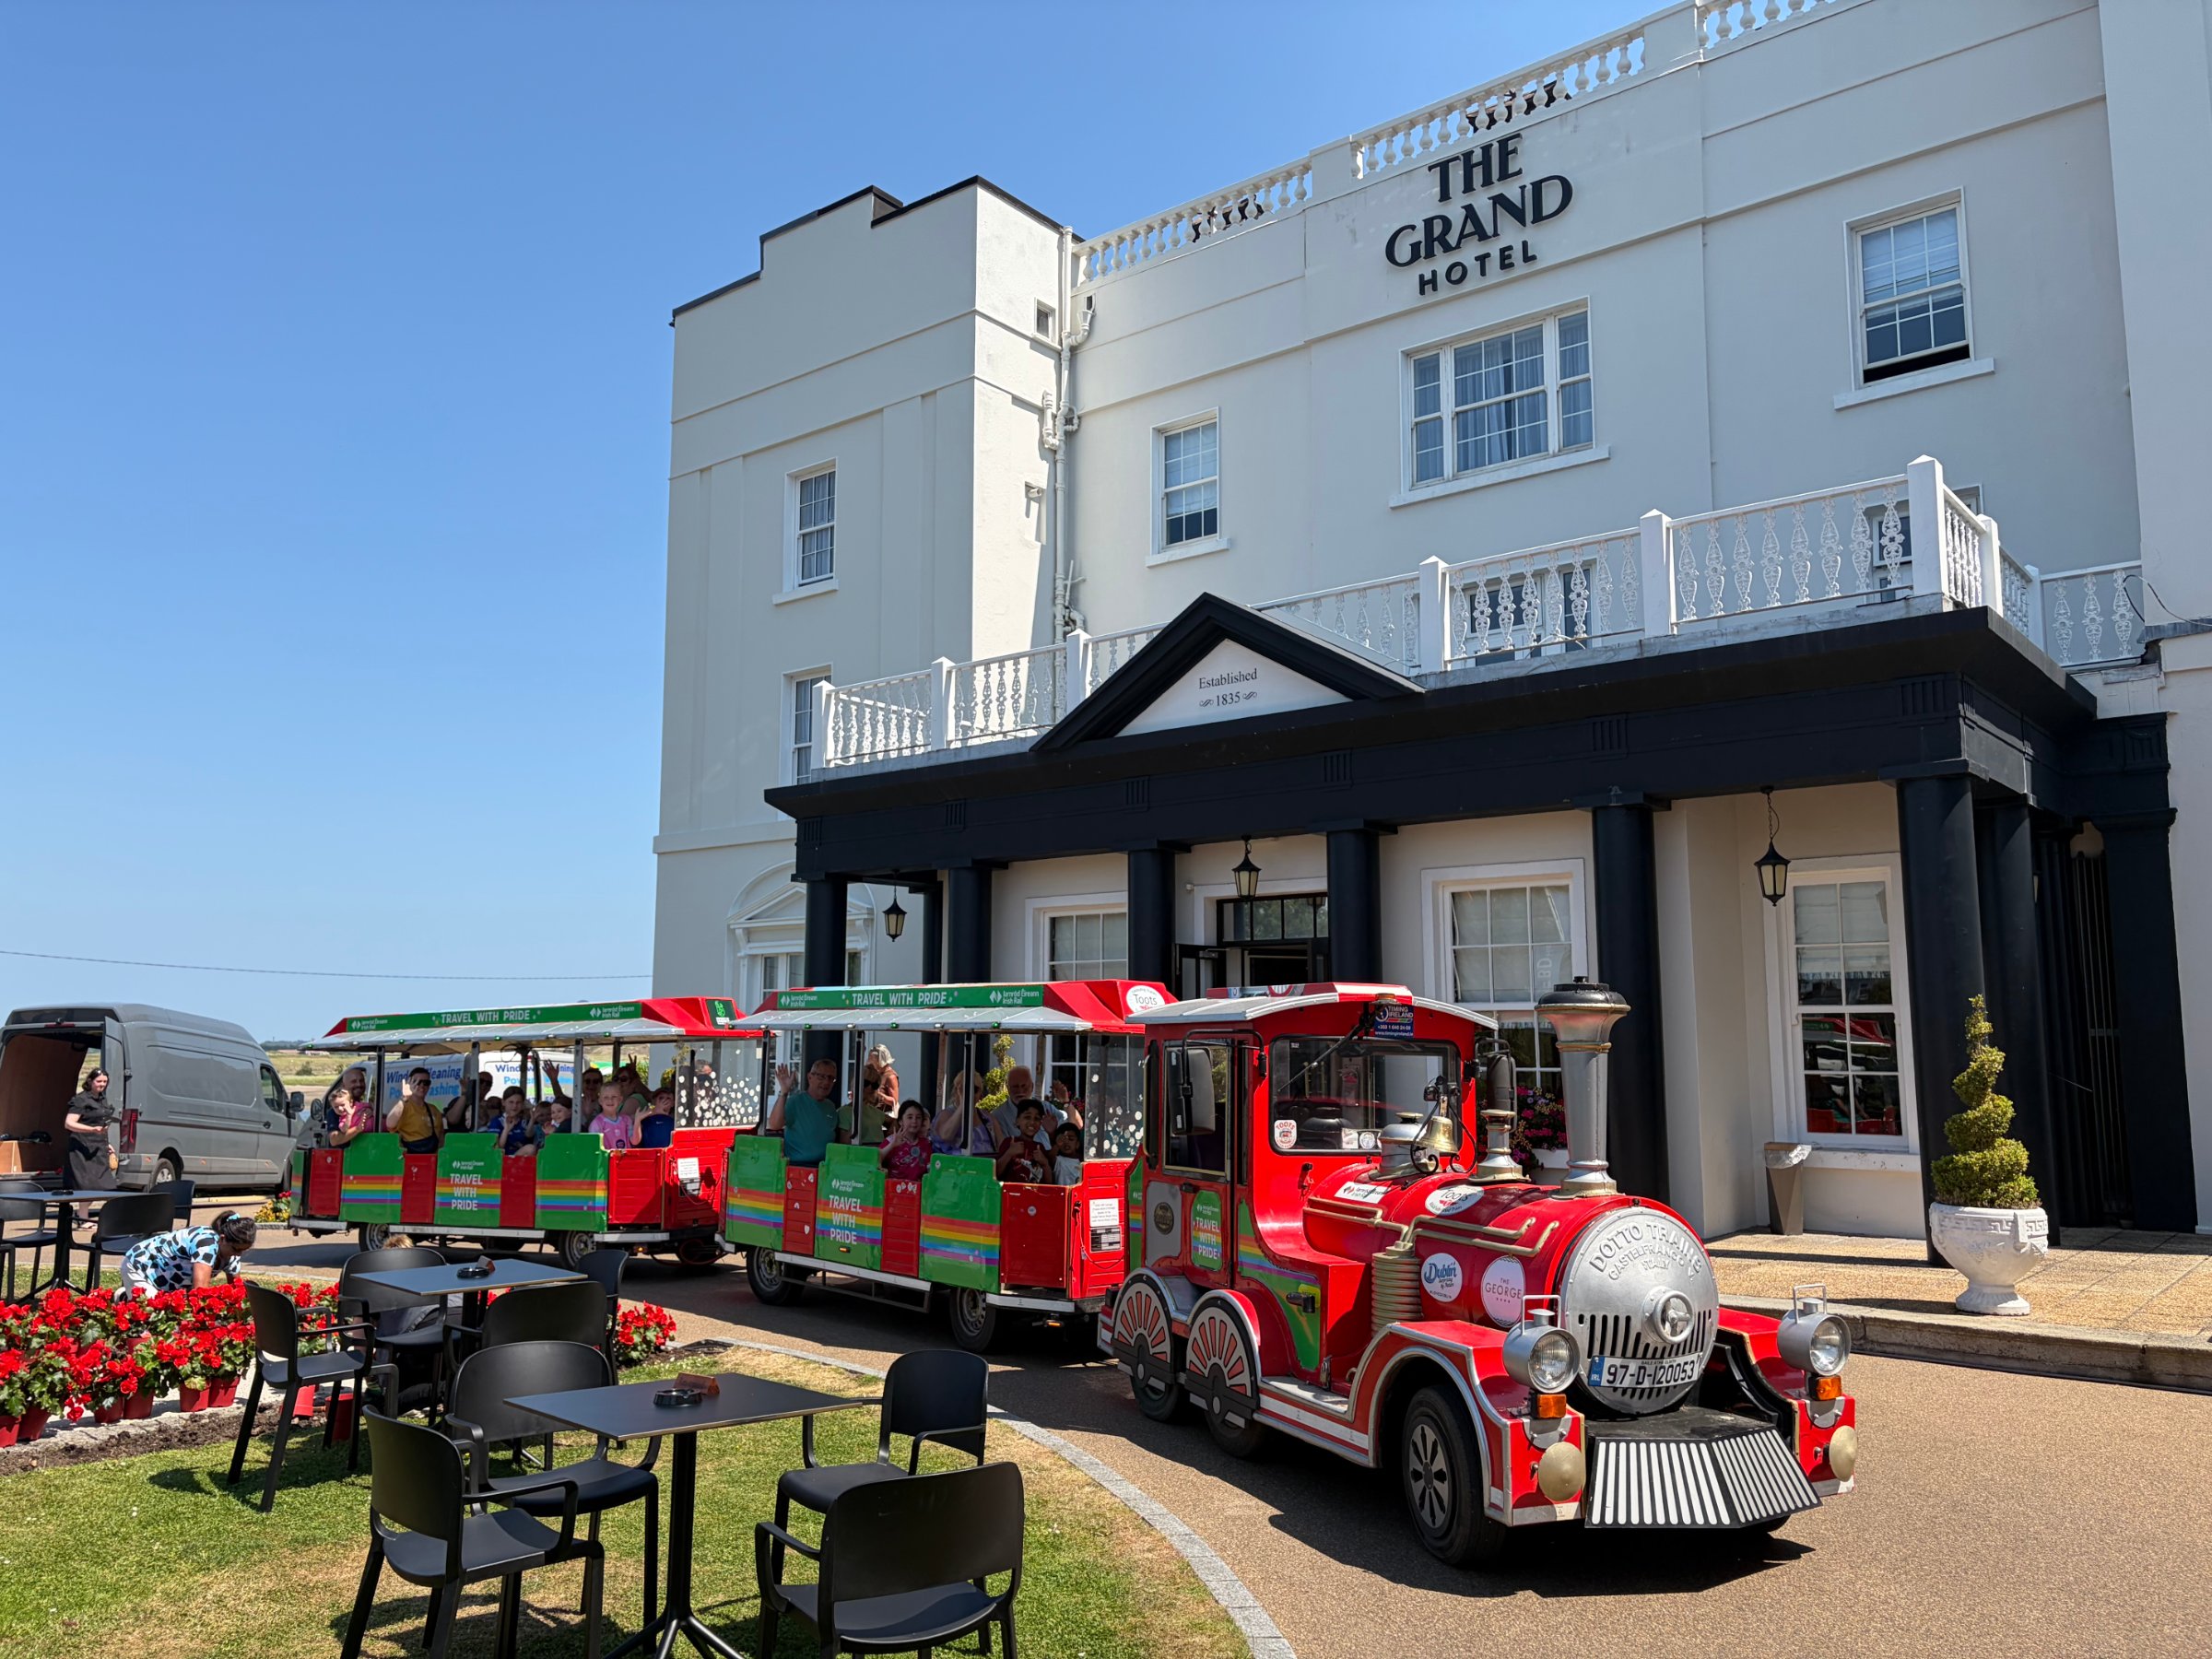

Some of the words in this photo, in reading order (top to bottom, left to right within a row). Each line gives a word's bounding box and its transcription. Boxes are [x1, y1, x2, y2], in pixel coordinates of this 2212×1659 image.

[1428, 133, 1523, 203] THE
[1385, 174, 1573, 267] GRAND
[1418, 240, 1537, 296] HOTEL
[1199, 667, 1257, 689] Established
[1217, 691, 1241, 707] 1835
[853, 993, 885, 1006] TRAVEL
[889, 993, 913, 1005] WITH
[918, 992, 947, 1005] PRIDE
[1133, 994, 1158, 1006] Toots
[441, 1012, 473, 1024] TRAVEL
[477, 1011, 500, 1022] WITH
[503, 1009, 530, 1021] PRIDE
[1276, 1121, 1295, 1130] TOOTS
[450, 1173, 483, 1185] TRAVEL
[453, 1186, 477, 1198] WITH
[452, 1199, 478, 1211] PRIDE
[829, 1194, 863, 1213] TRAVEL
[832, 1212, 856, 1229] WITH
[1195, 1217, 1220, 1233] TRAVEL
[830, 1228, 857, 1245] PRIDE
[1199, 1232, 1217, 1245] WITH
[1198, 1244, 1218, 1260] PRIDE
[1589, 1221, 1643, 1273] DOTTO
[1646, 1221, 1703, 1274] TRAINS
[1424, 1261, 1458, 1284] Dublin
[1485, 1282, 1522, 1300] GEORGE
[1591, 1373, 1601, 1382] IRL
[1606, 1359, 1695, 1385] 97-D-120053
